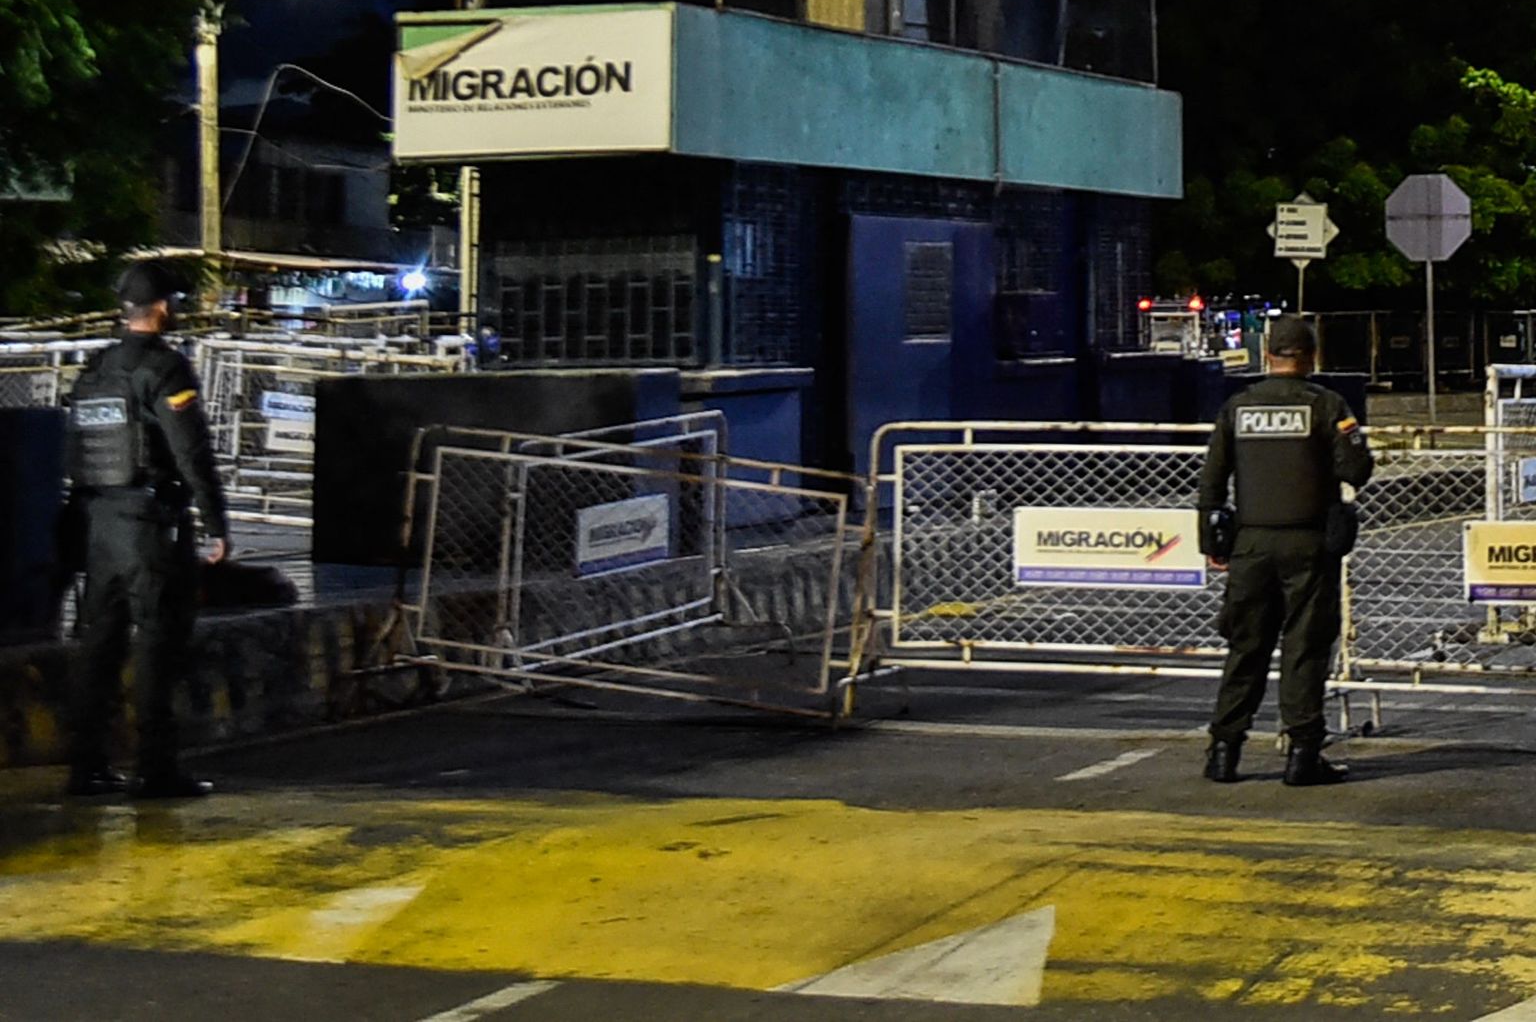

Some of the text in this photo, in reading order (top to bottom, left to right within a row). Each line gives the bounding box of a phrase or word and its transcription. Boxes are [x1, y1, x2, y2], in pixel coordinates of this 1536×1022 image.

[408, 55, 632, 101] MIGRACIÓN
[1241, 412, 1304, 432] POLICIA
[1037, 527, 1164, 549] MIGRACIÓN
